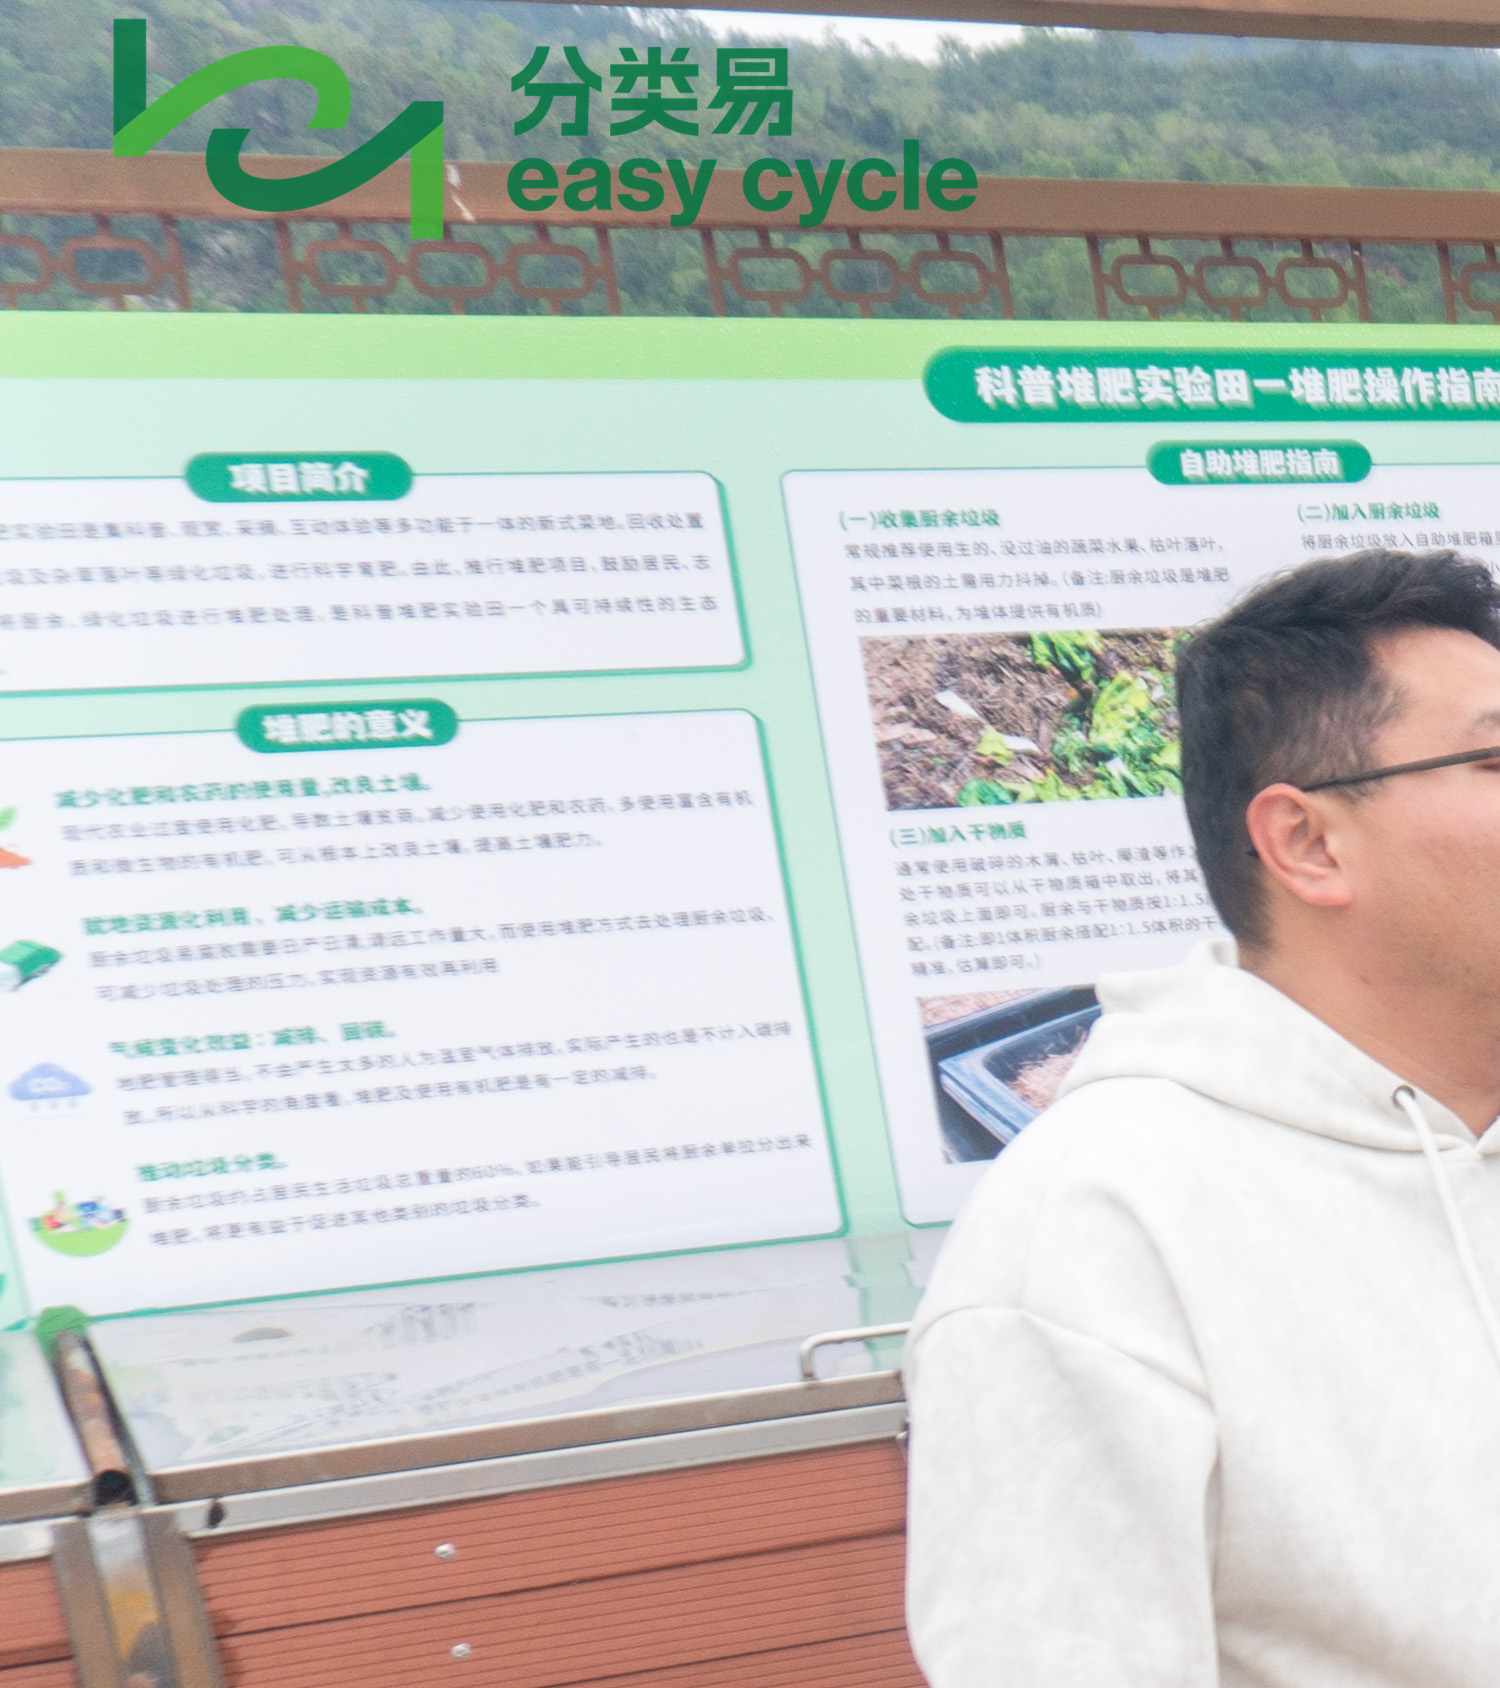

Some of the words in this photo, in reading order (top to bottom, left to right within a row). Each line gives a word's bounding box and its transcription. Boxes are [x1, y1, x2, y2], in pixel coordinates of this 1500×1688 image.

[228, 462, 369, 494] 项目简介
[1180, 449, 1338, 479] 自助堆肥指南
[263, 709, 433, 744] 堆肥的意义
[900, 868, 1204, 902] 处干物质可以从干物质箱中取出，将其
